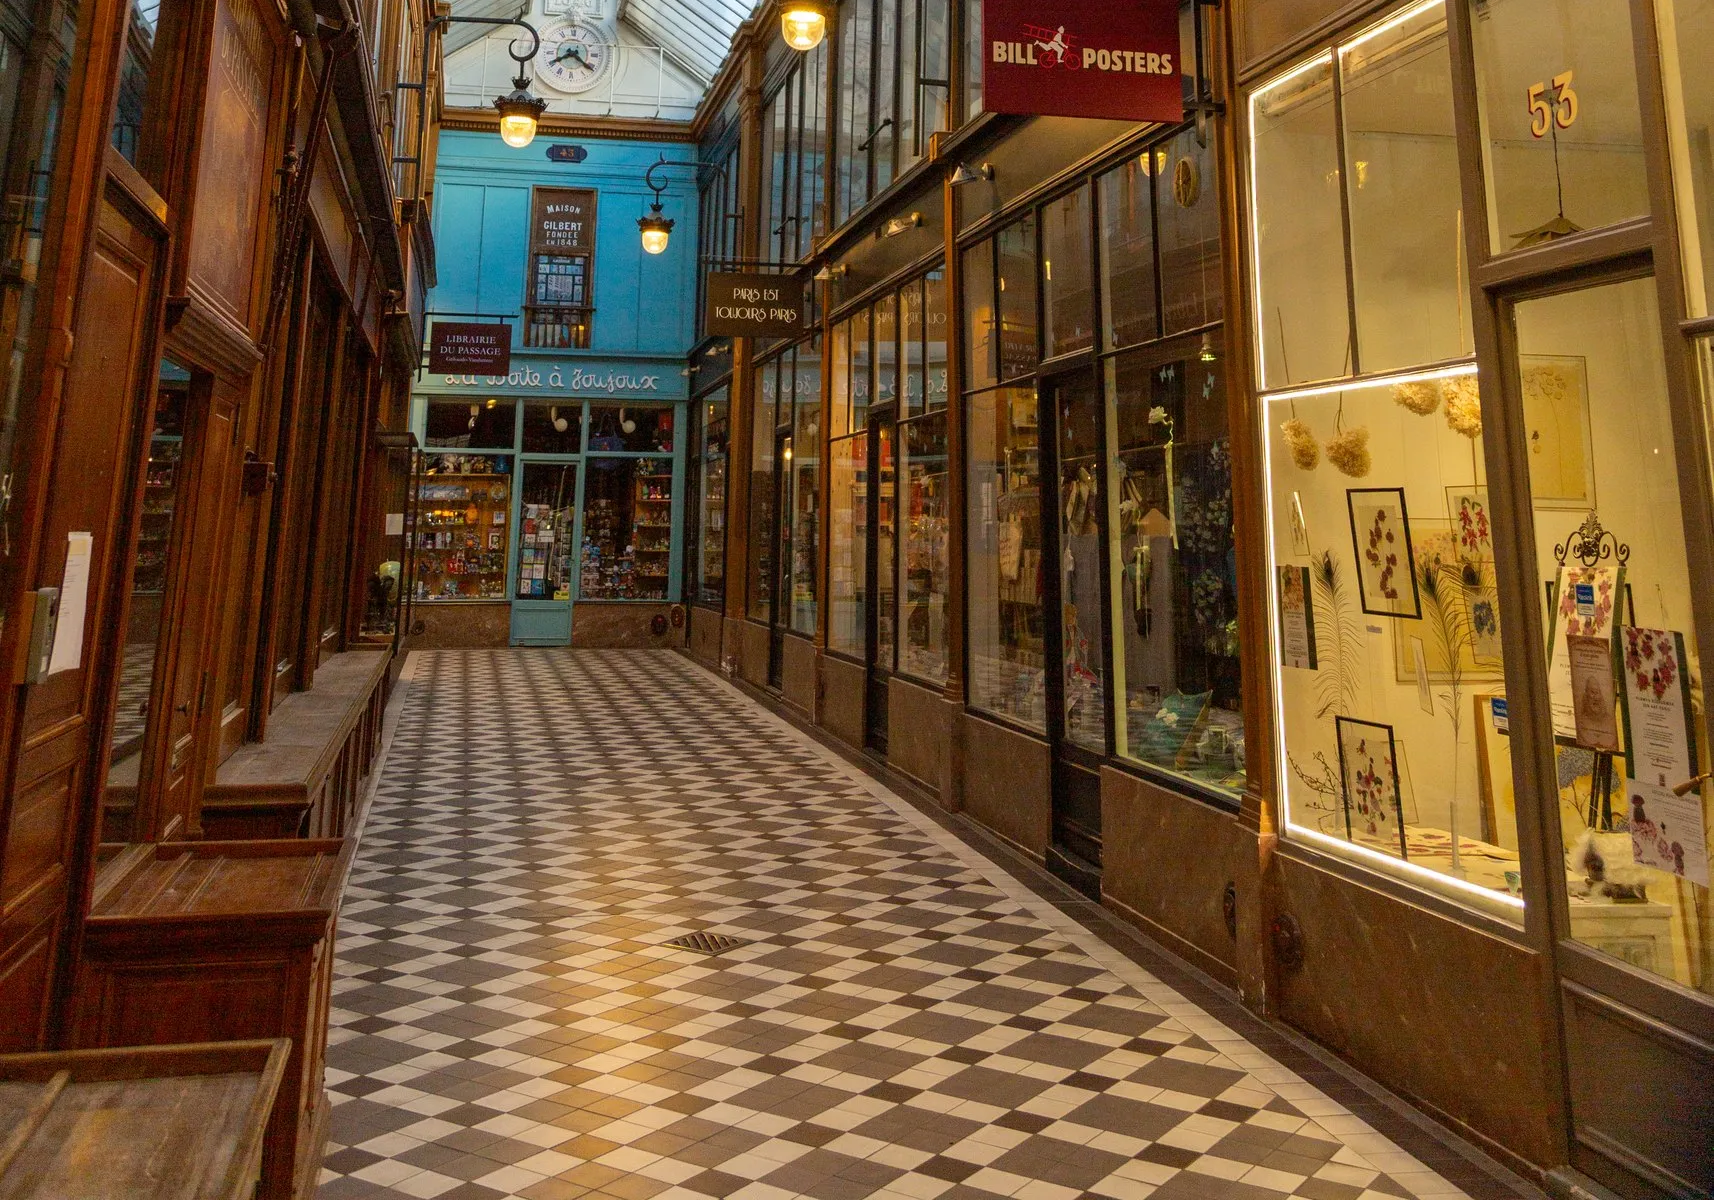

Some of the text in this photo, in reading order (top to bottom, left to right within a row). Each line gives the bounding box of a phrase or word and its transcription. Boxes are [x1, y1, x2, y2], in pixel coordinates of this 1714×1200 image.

[993, 41, 1173, 75] BILL POSTERS
[1527, 70, 1578, 138] 53
[546, 204, 581, 214] MAISON
[543, 221, 582, 231] GILBERT
[733, 288, 779, 303] PARIS EST
[716, 307, 797, 323] TOUJOURS PARIS
[446, 334, 496, 345] LIBRAIRIE
[440, 345, 501, 356] DU PASSAGE
[549, 365, 565, 387] à
